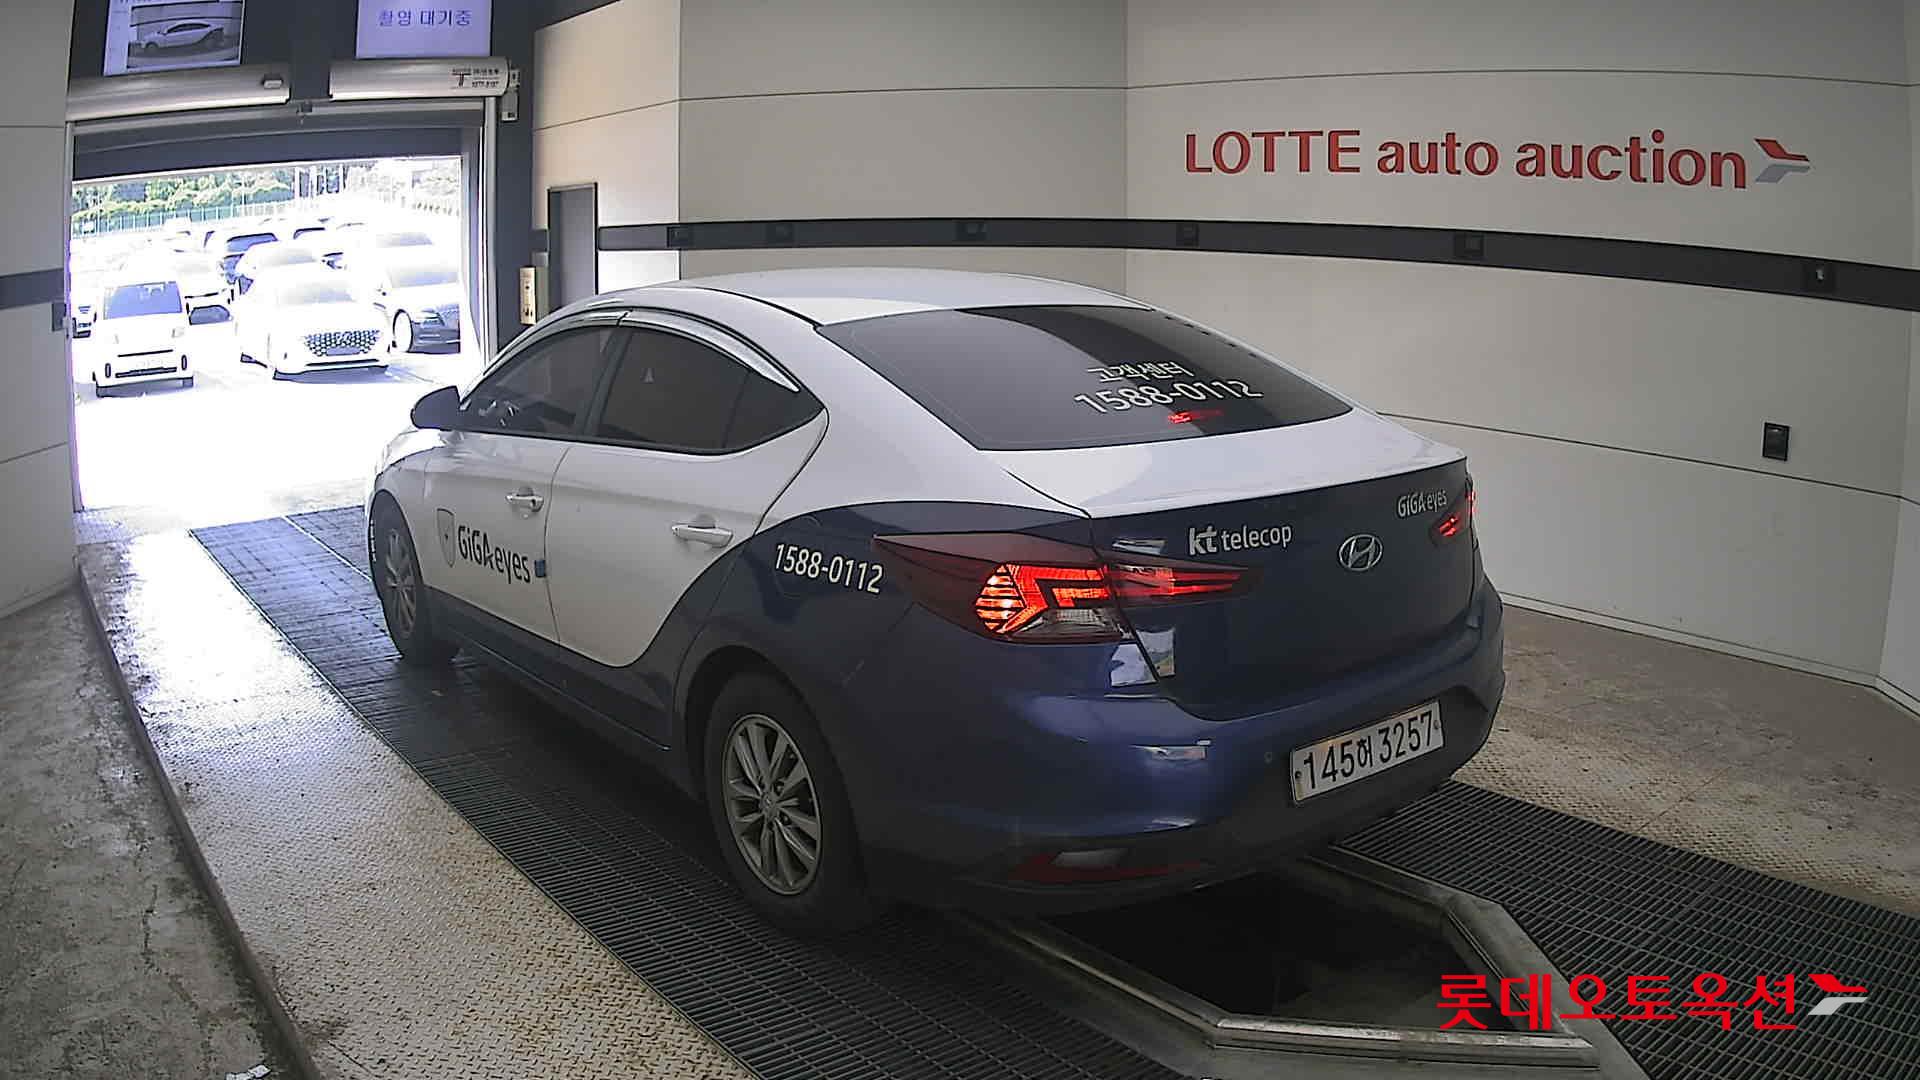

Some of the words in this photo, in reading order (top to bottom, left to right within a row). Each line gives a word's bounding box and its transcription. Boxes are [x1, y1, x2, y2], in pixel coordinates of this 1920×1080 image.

[420, 9, 472, 27] 대기중
[1185, 130, 1361, 173] LOTTE
[1377, 133, 1499, 177] auto
[1515, 129, 1747, 189] auction
[1087, 361, 1194, 382] 고객센터
[1074, 379, 1264, 414] 1588-0112
[1222, 524, 1292, 552] telecop
[774, 542, 885, 594] 1588-0112
